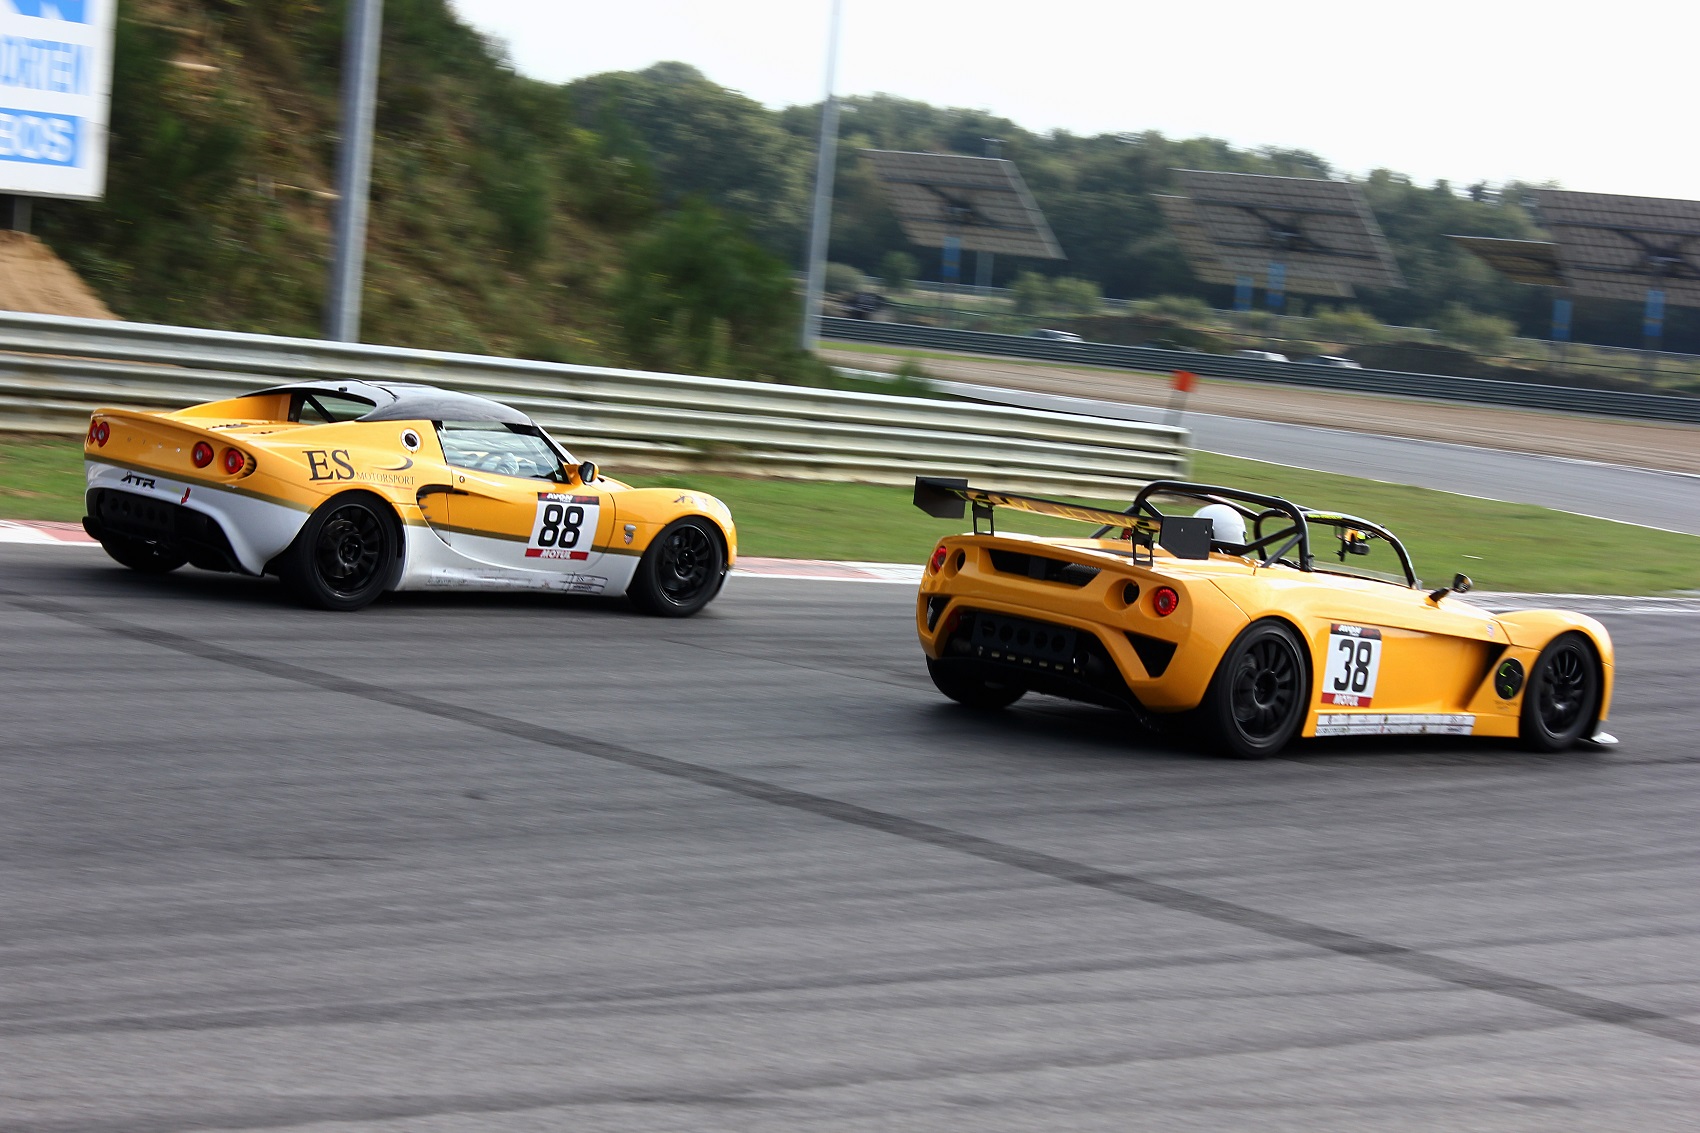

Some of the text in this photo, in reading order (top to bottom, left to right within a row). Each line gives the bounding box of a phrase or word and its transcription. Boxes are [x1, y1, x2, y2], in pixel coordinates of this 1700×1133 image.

[301, 449, 416, 485] ES MOTORSPORT
[537, 503, 585, 549] 88
[540, 549, 571, 560] MOTUL
[1333, 638, 1373, 693] 38
